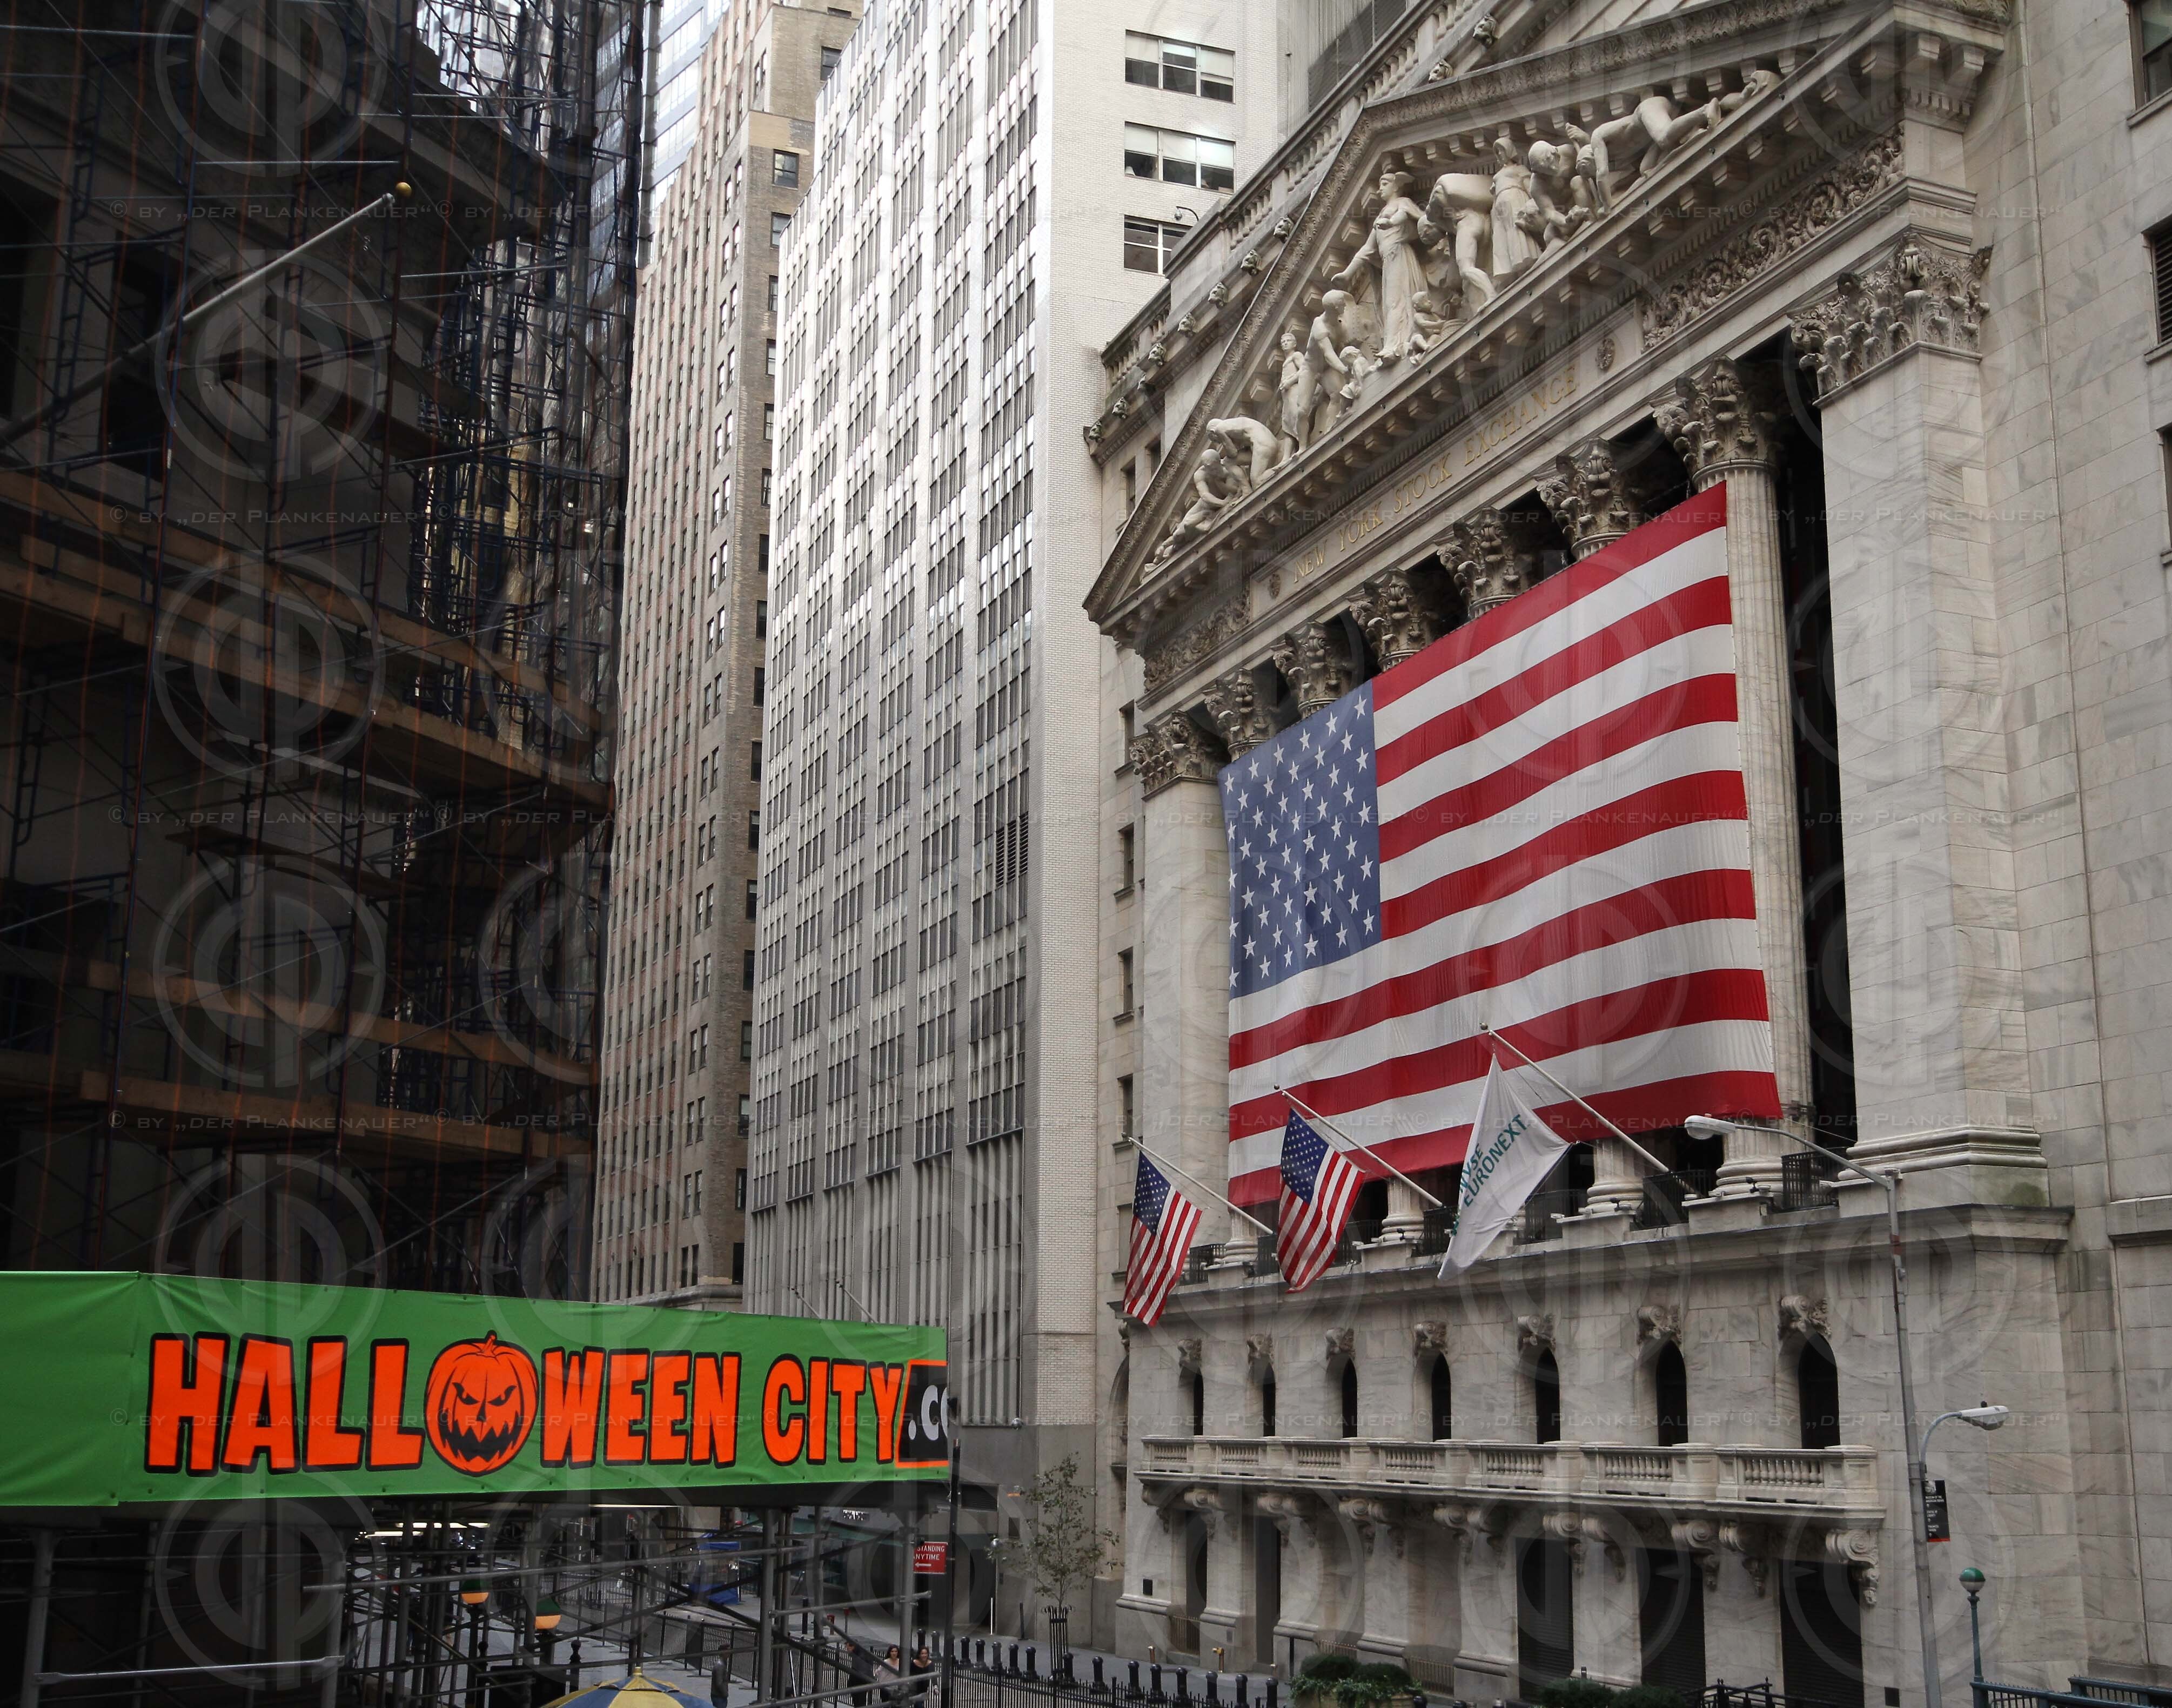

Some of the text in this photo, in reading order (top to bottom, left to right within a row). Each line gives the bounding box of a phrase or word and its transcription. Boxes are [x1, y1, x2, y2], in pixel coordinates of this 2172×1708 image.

[1294, 365, 1579, 583] NEW YORK STOCK EXCHANGE
[1464, 1114, 1527, 1207] EURONEXT
[761, 1353, 904, 1467] CITY
